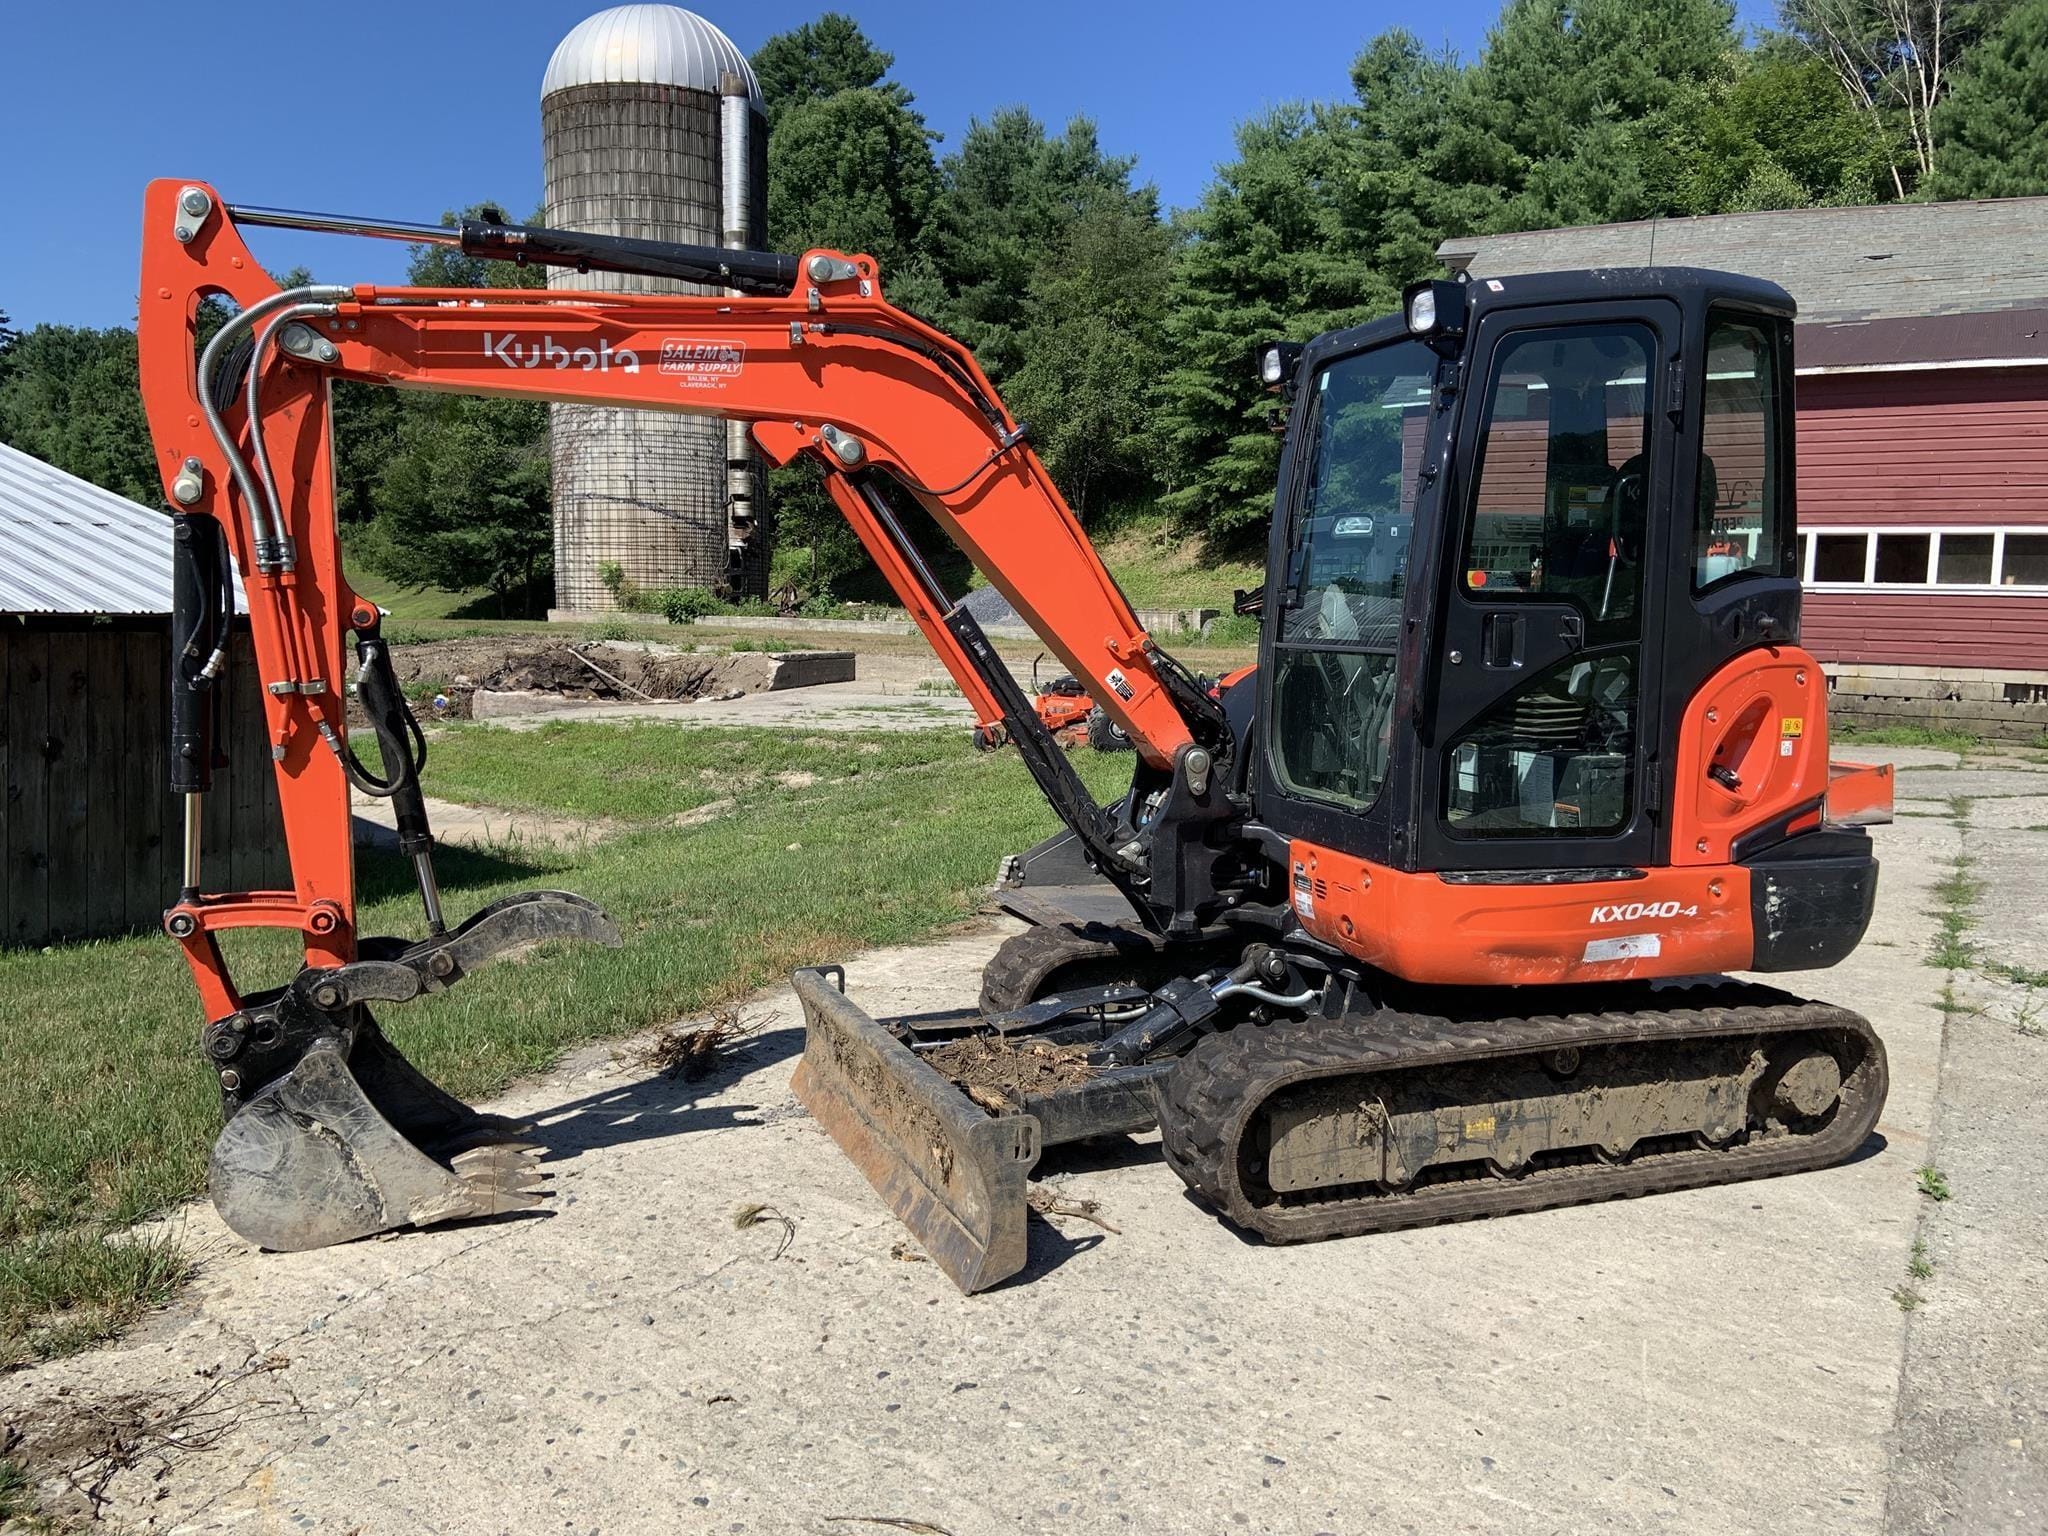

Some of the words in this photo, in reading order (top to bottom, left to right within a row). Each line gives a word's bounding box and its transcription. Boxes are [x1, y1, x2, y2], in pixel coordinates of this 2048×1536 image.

[483, 332, 640, 374] Kubota
[663, 344, 719, 360] SALEM
[662, 362, 695, 371] FARM
[698, 363, 741, 373] SUPPLY
[1590, 901, 1698, 924] KX040-4
